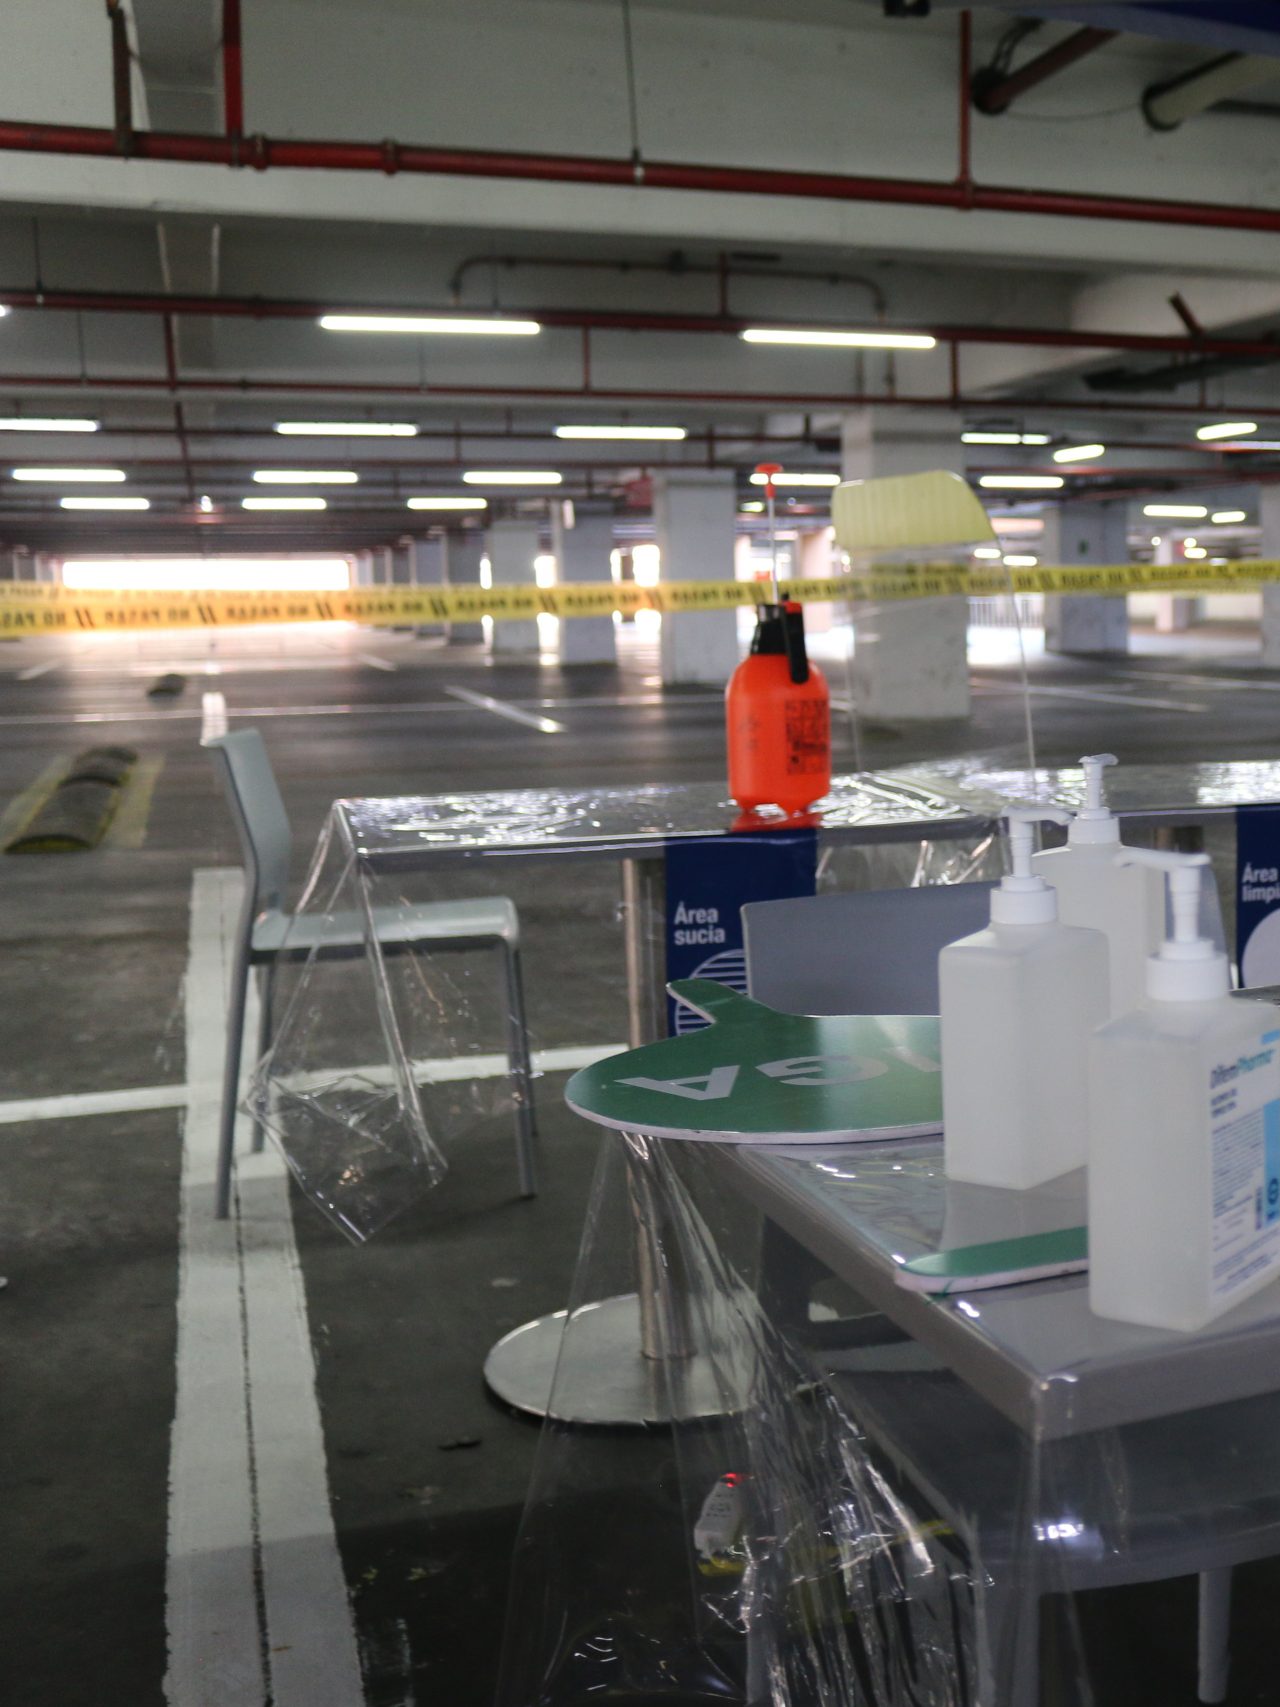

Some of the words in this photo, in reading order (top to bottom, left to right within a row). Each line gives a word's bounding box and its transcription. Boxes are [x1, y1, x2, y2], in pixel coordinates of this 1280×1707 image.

[1242, 862, 1278, 884] Área
[674, 901, 719, 925] Área
[674, 926, 726, 946] sucia
[614, 1045, 942, 1101] IGA
